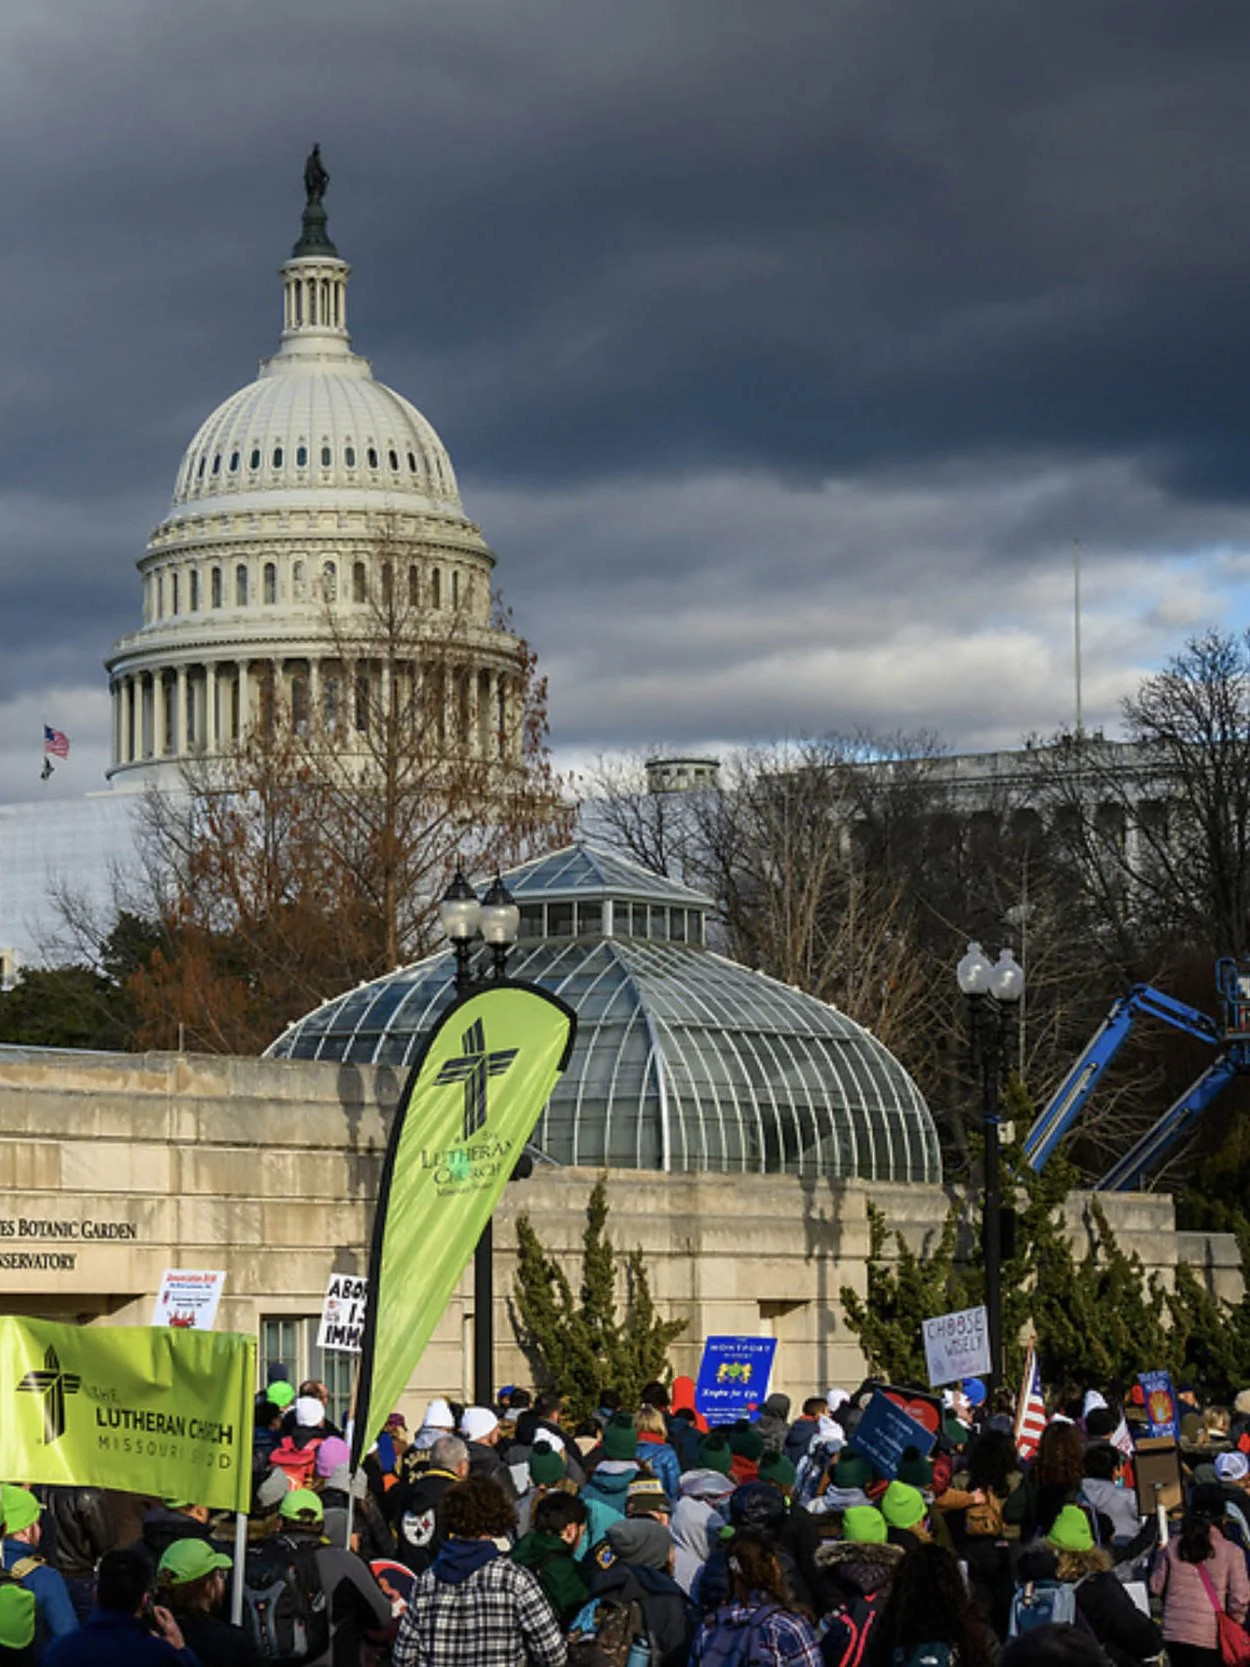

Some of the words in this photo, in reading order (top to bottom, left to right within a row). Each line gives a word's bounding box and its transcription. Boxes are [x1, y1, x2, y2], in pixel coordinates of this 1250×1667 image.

[19, 1218, 79, 1238] BOTANIC
[81, 1221, 137, 1239] GARDEN
[927, 1307, 984, 1339] CHOOSE
[96, 1406, 185, 1437] LUTHERAN
